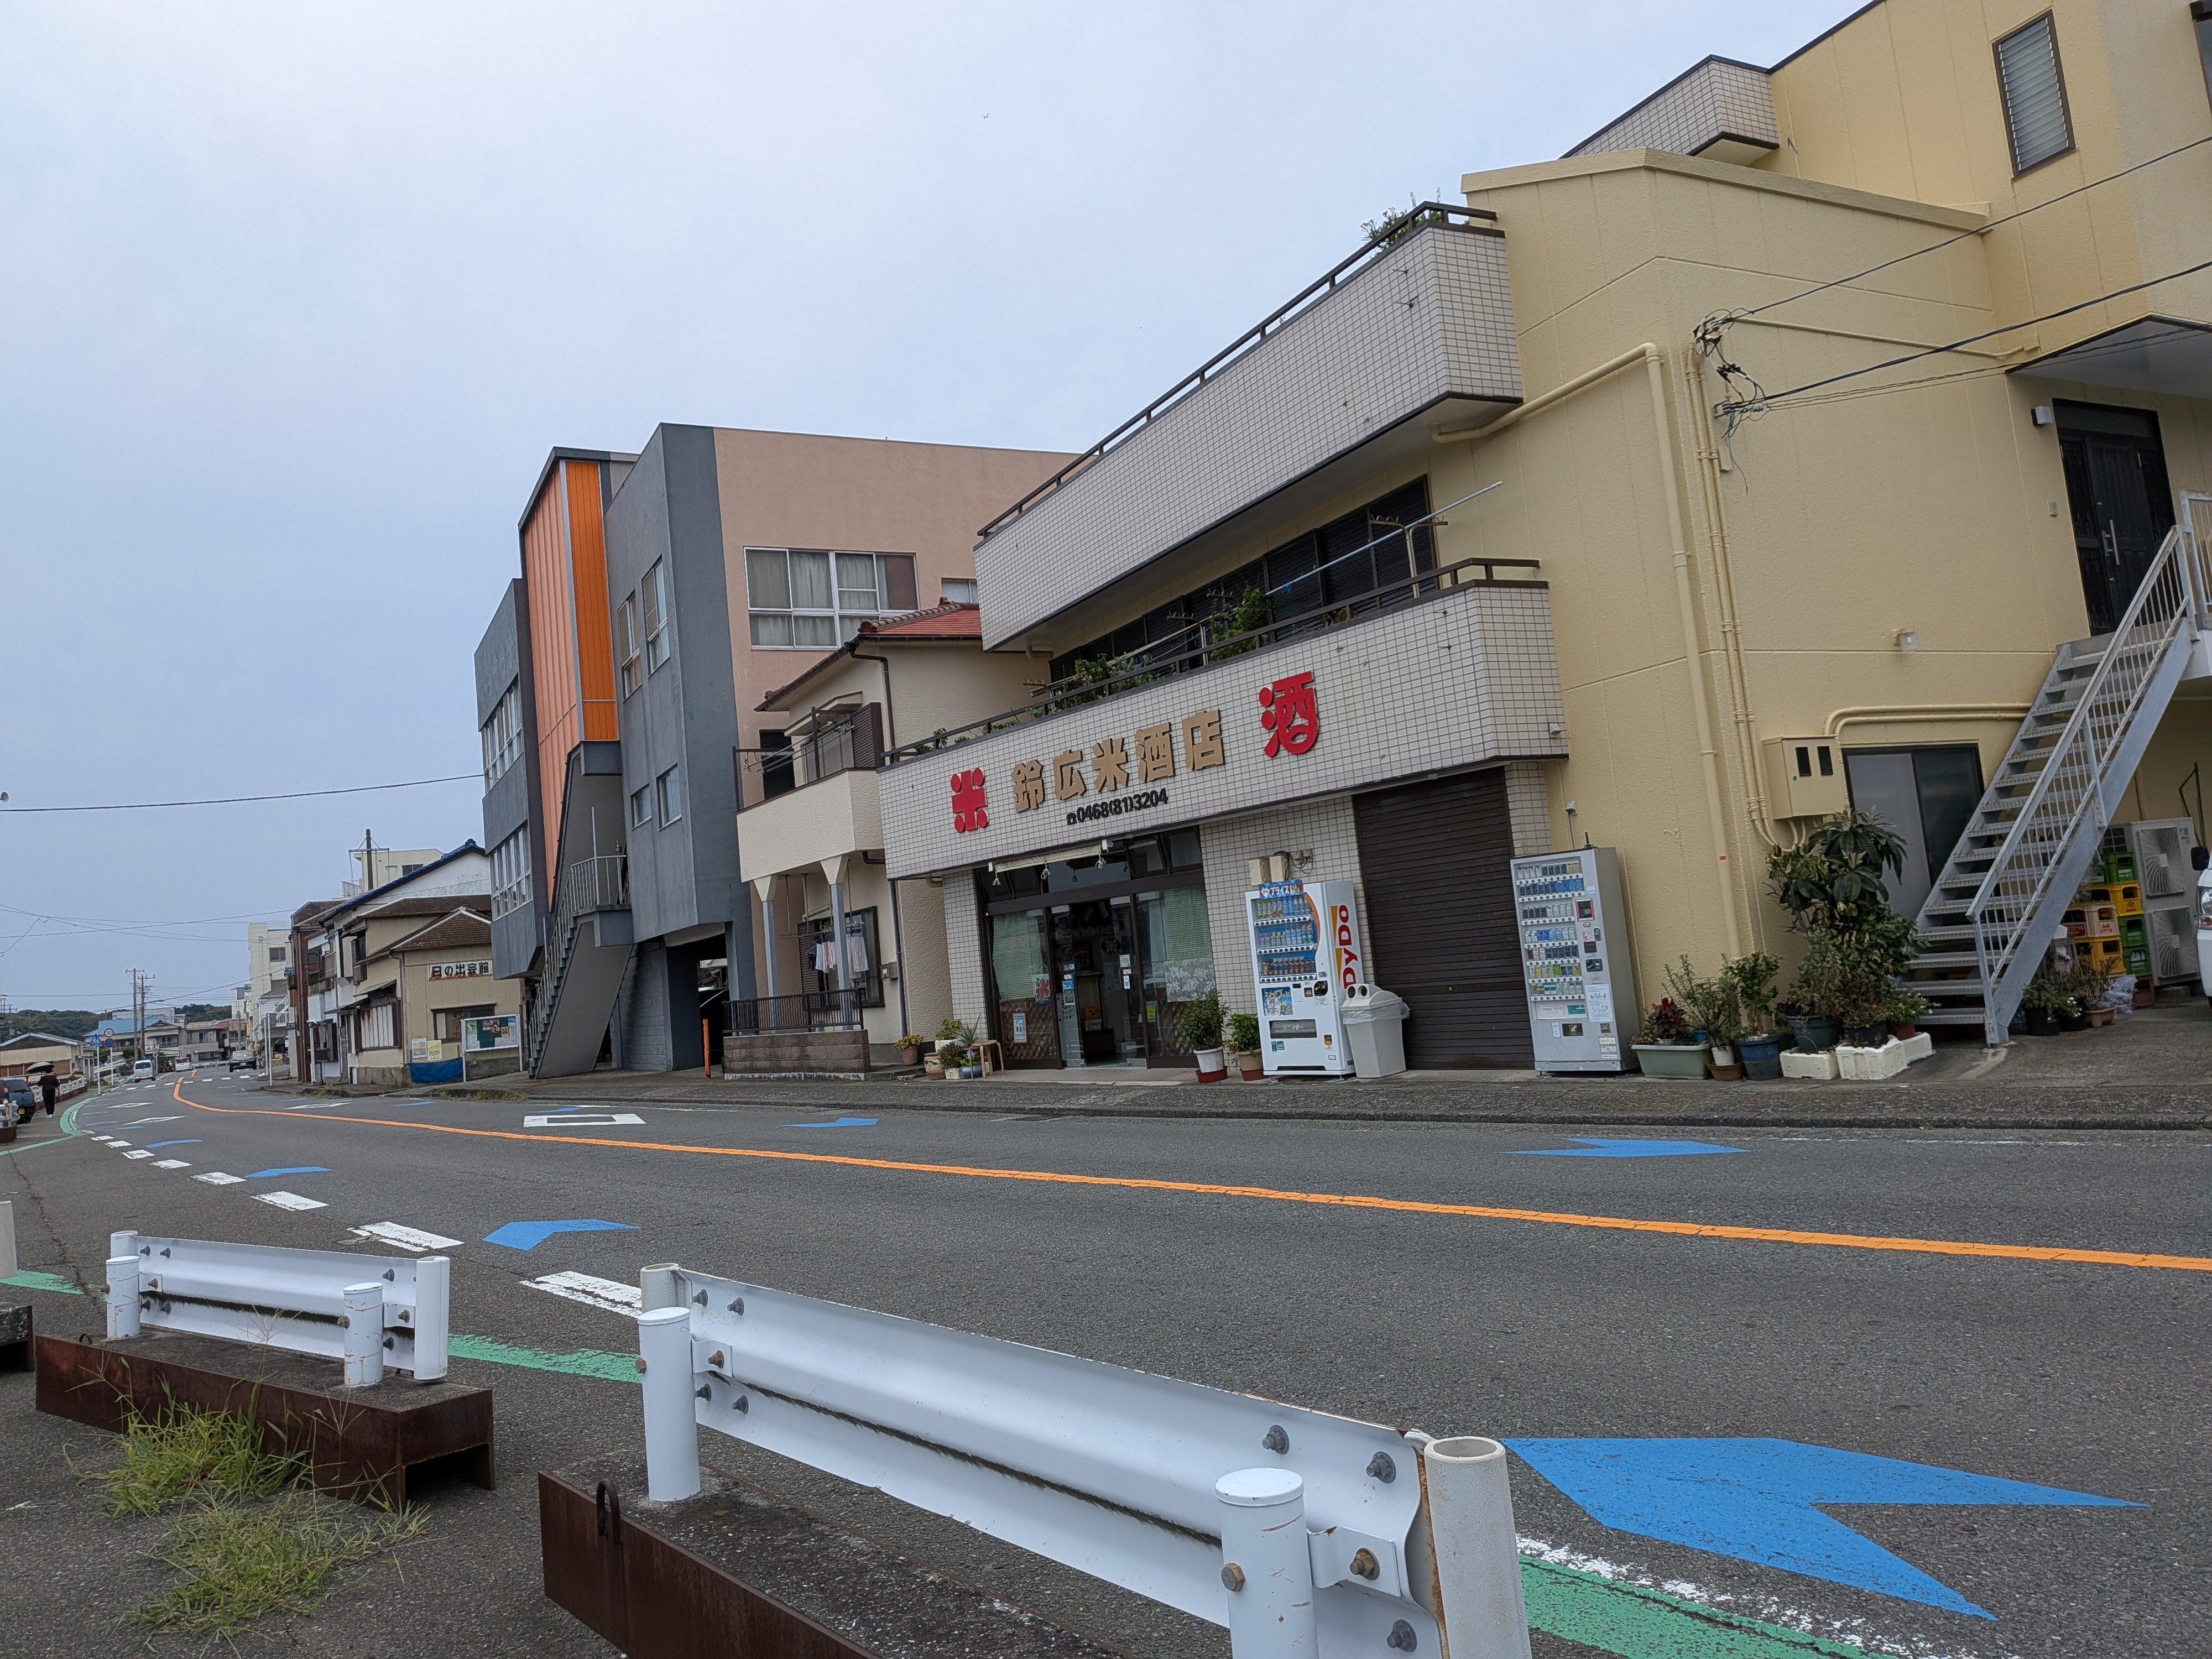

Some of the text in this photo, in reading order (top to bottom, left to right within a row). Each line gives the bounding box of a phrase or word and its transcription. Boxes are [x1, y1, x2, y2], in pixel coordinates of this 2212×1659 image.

[1259, 671, 1319, 755] 酒
[1011, 709, 1225, 813] 鈴広米酒店
[431, 962, 489, 977] 日の出会館
